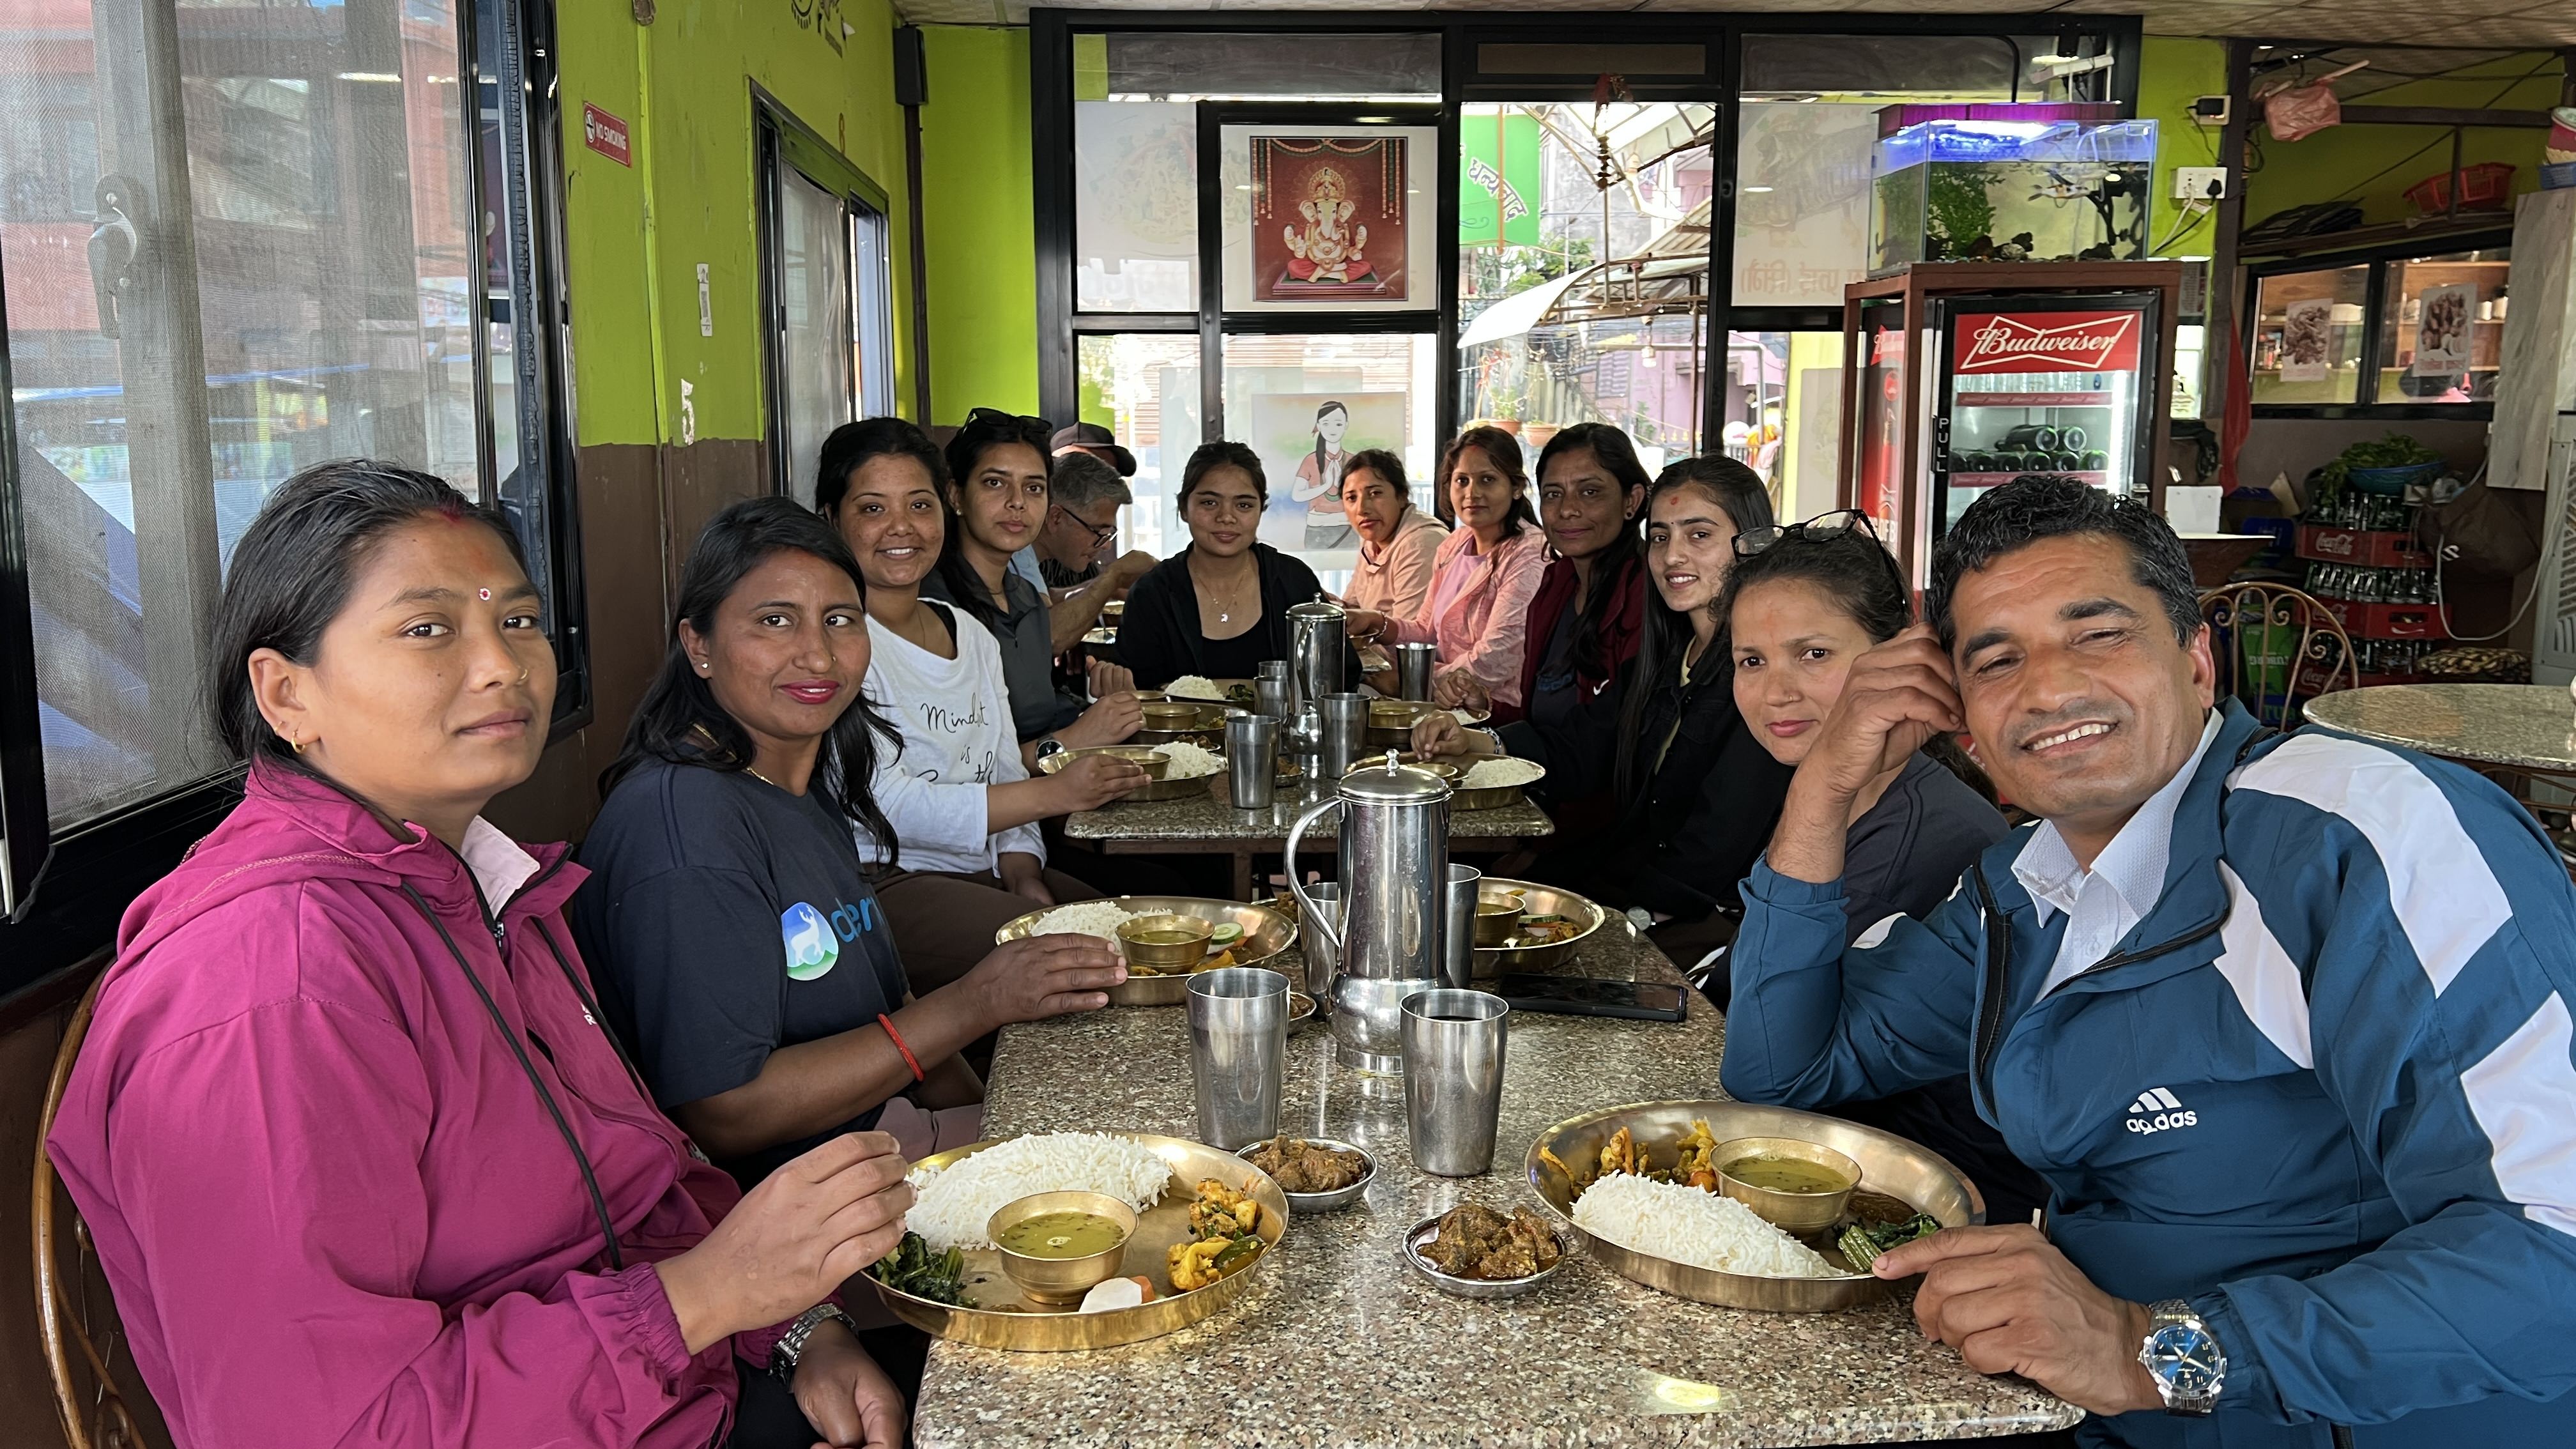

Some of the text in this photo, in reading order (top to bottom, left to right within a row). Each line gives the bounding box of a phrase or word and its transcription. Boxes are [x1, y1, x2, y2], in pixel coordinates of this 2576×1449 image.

[595, 121, 627, 150] NO SMOKING
[1973, 328, 2117, 355] Budweiser
[1936, 417, 1949, 472] PULL
[920, 692, 989, 733] Mindt
[960, 744, 970, 764] is
[2126, 1110, 2198, 1136] addas
